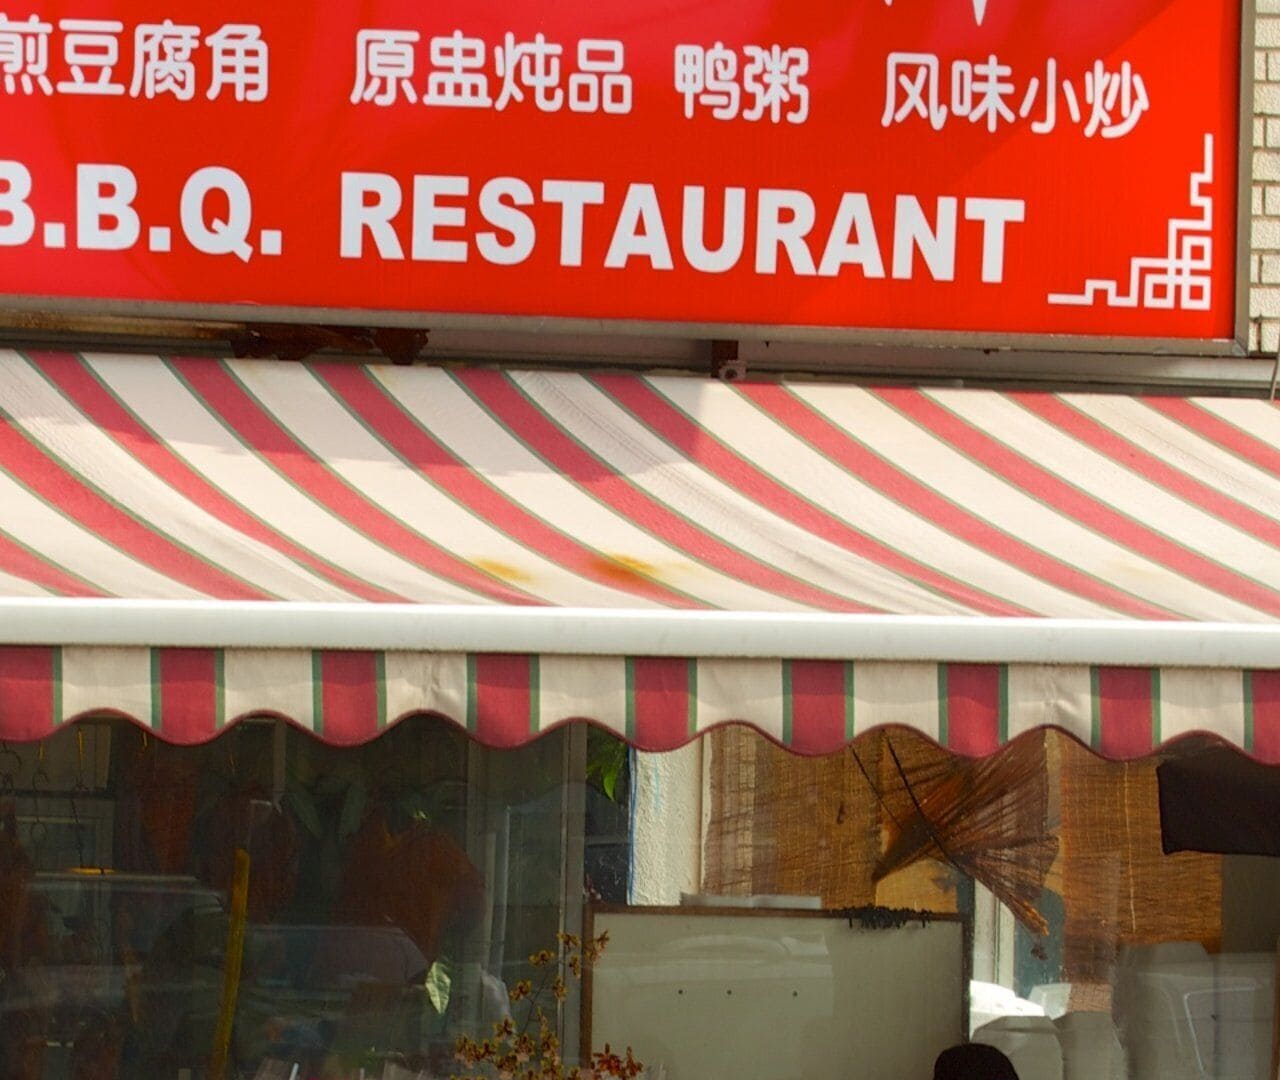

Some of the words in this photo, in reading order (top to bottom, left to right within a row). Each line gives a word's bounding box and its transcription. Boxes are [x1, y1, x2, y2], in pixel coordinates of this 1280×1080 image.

[349, 26, 633, 117] 原盅炖品
[672, 40, 812, 126] 鸭粥
[880, 50, 1150, 141] 风味小炒
[339, 172, 1026, 284] RESTAURANT
